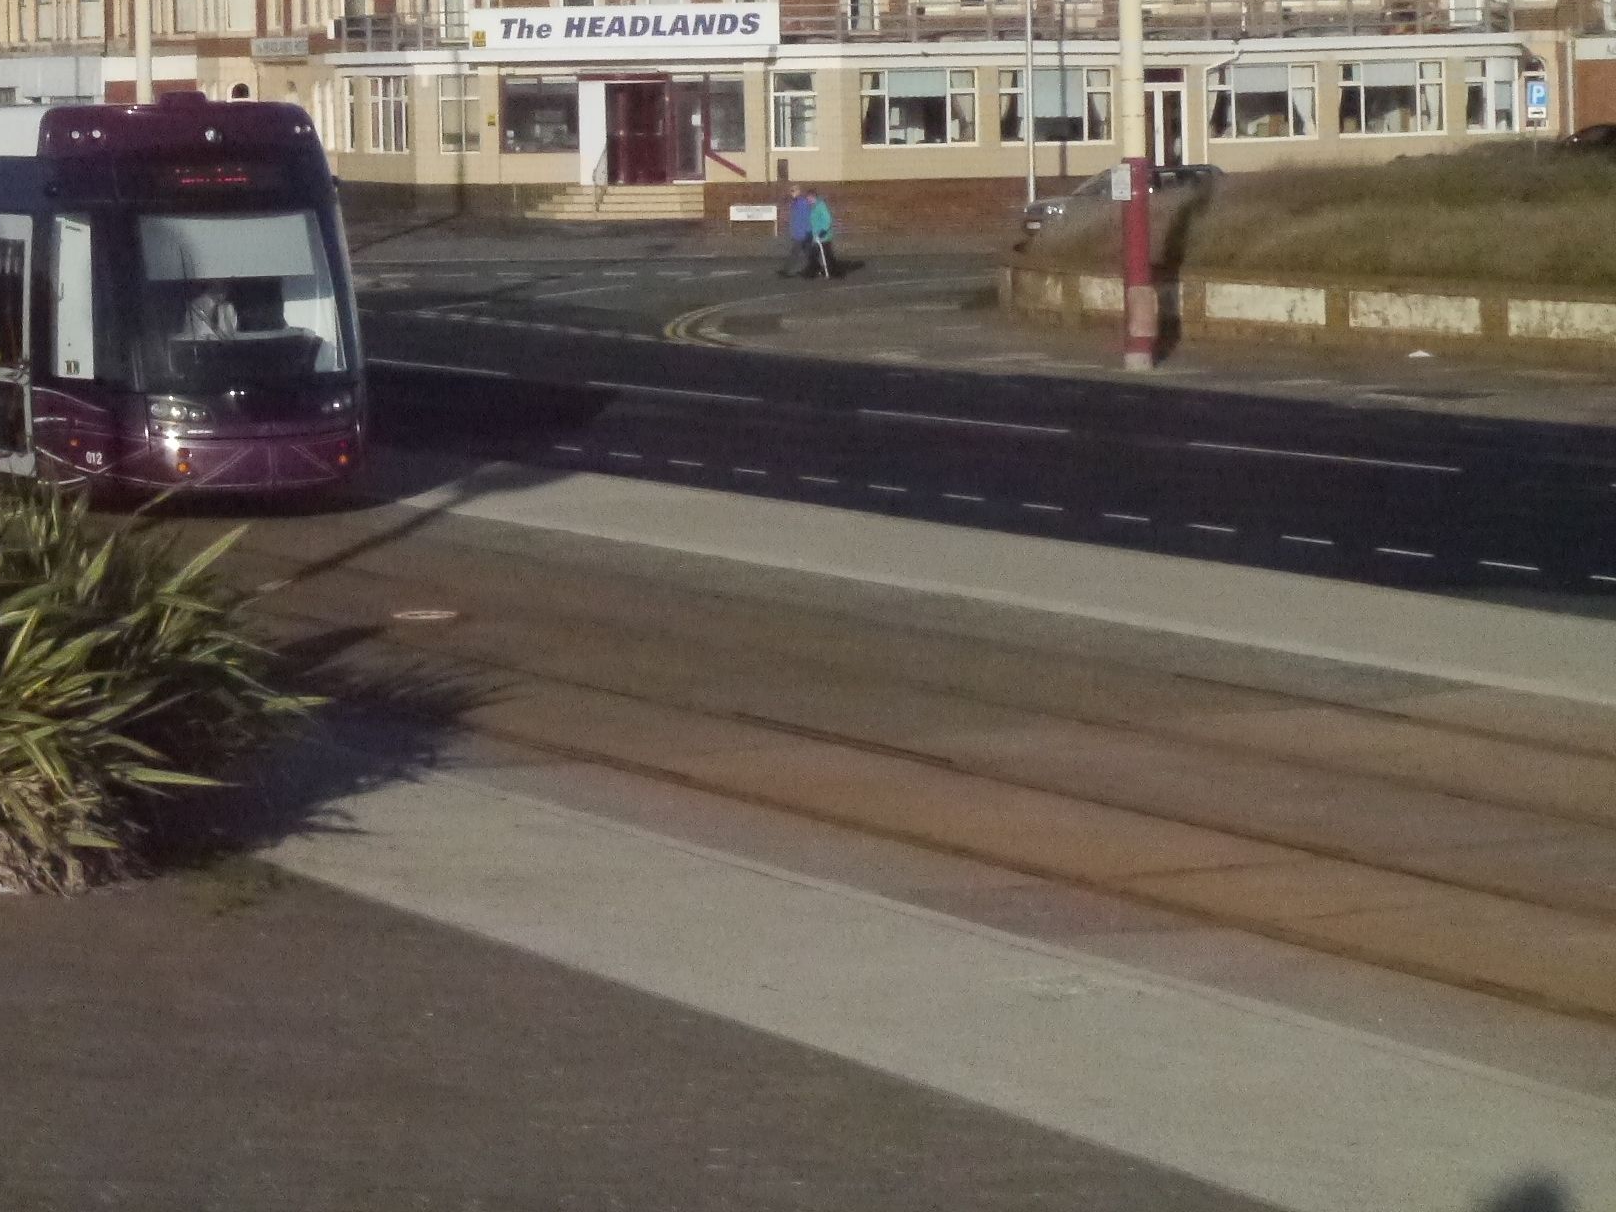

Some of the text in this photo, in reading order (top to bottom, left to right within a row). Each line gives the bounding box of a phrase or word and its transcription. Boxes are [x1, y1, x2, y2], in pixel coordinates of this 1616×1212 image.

[500, 13, 761, 39] The HEADLANDS
[1532, 85, 1545, 104] P
